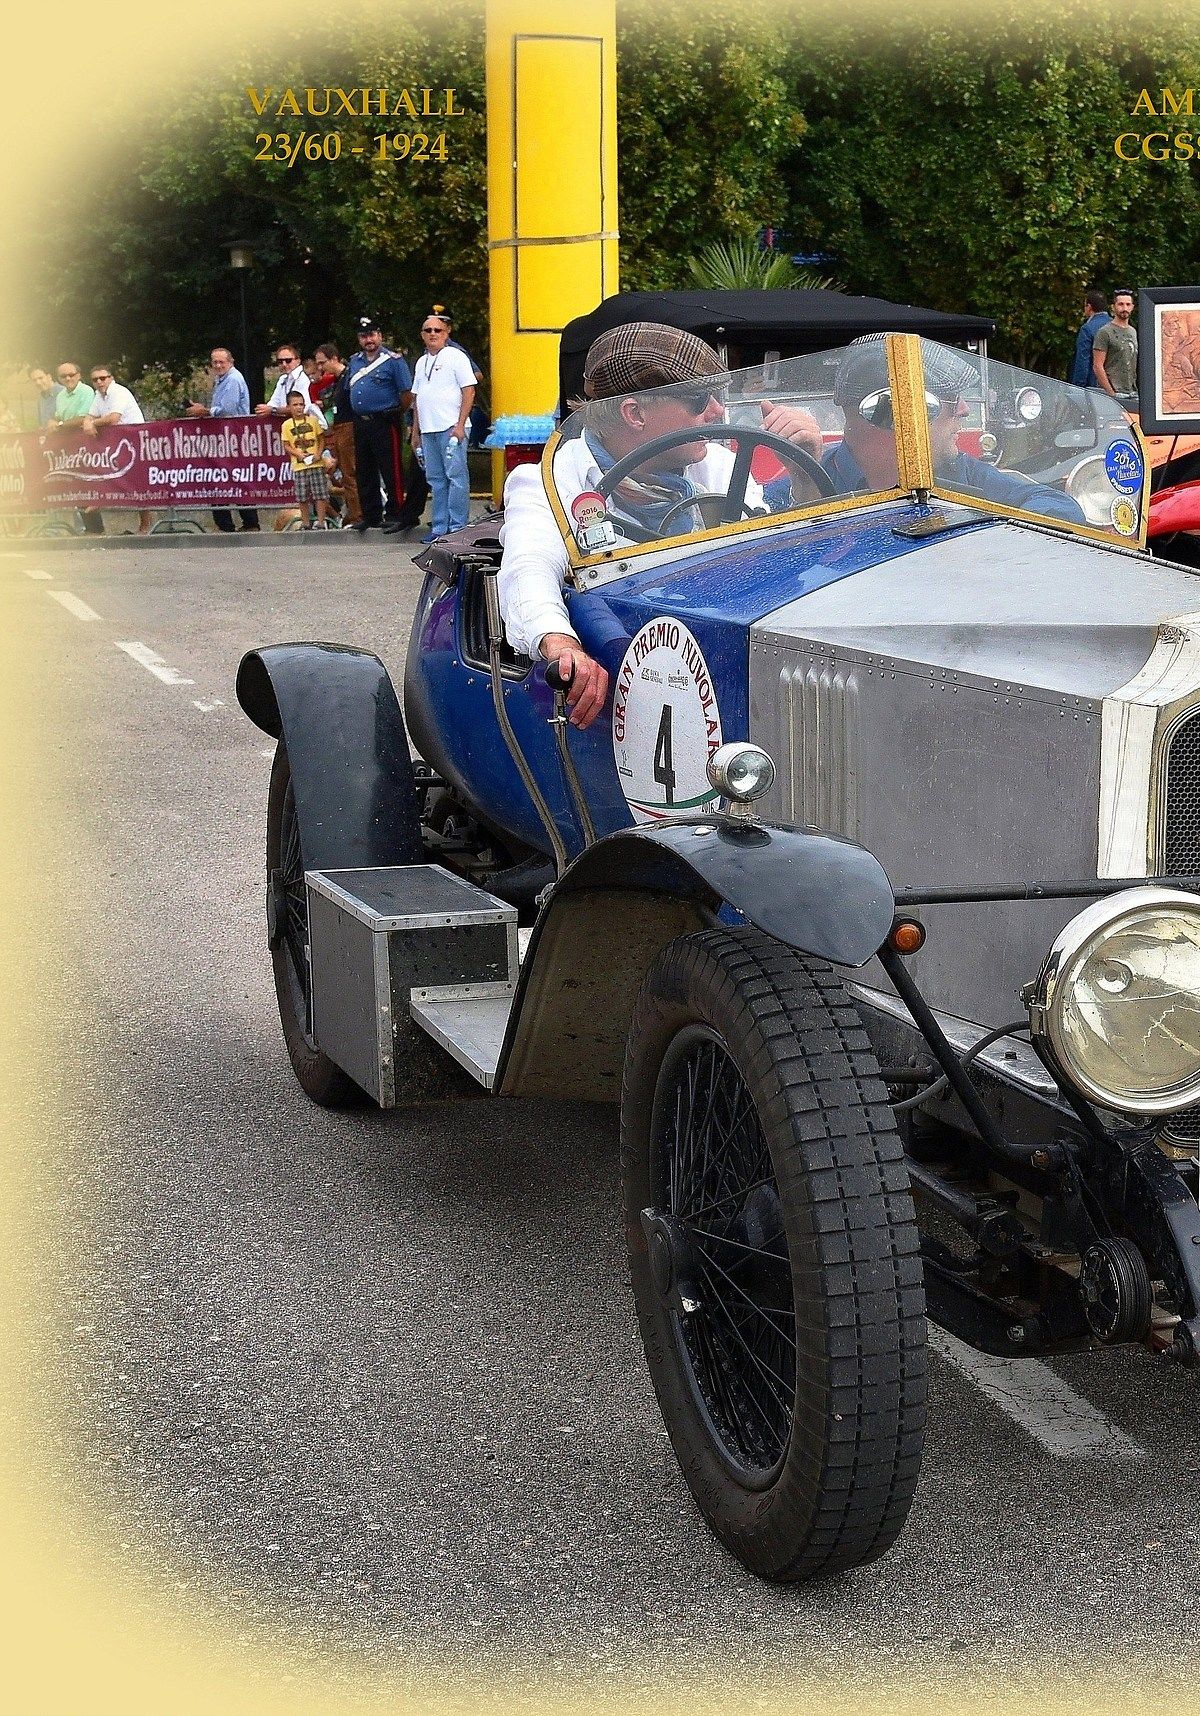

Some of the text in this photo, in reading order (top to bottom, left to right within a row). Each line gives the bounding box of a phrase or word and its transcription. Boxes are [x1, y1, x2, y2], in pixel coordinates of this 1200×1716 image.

[138, 430, 171, 461] Fiera
[173, 426, 239, 460] Nazionale
[242, 425, 262, 457] del
[149, 463, 229, 487] Borgofranco
[232, 463, 253, 482] sul
[258, 465, 276, 482] Po
[1113, 451, 1136, 471] 2016
[176, 488, 242, 499] www.tuberfood.it
[615, 660, 635, 742] GRAN
[633, 623, 680, 667] PREMIO
[654, 704, 677, 806] 4
